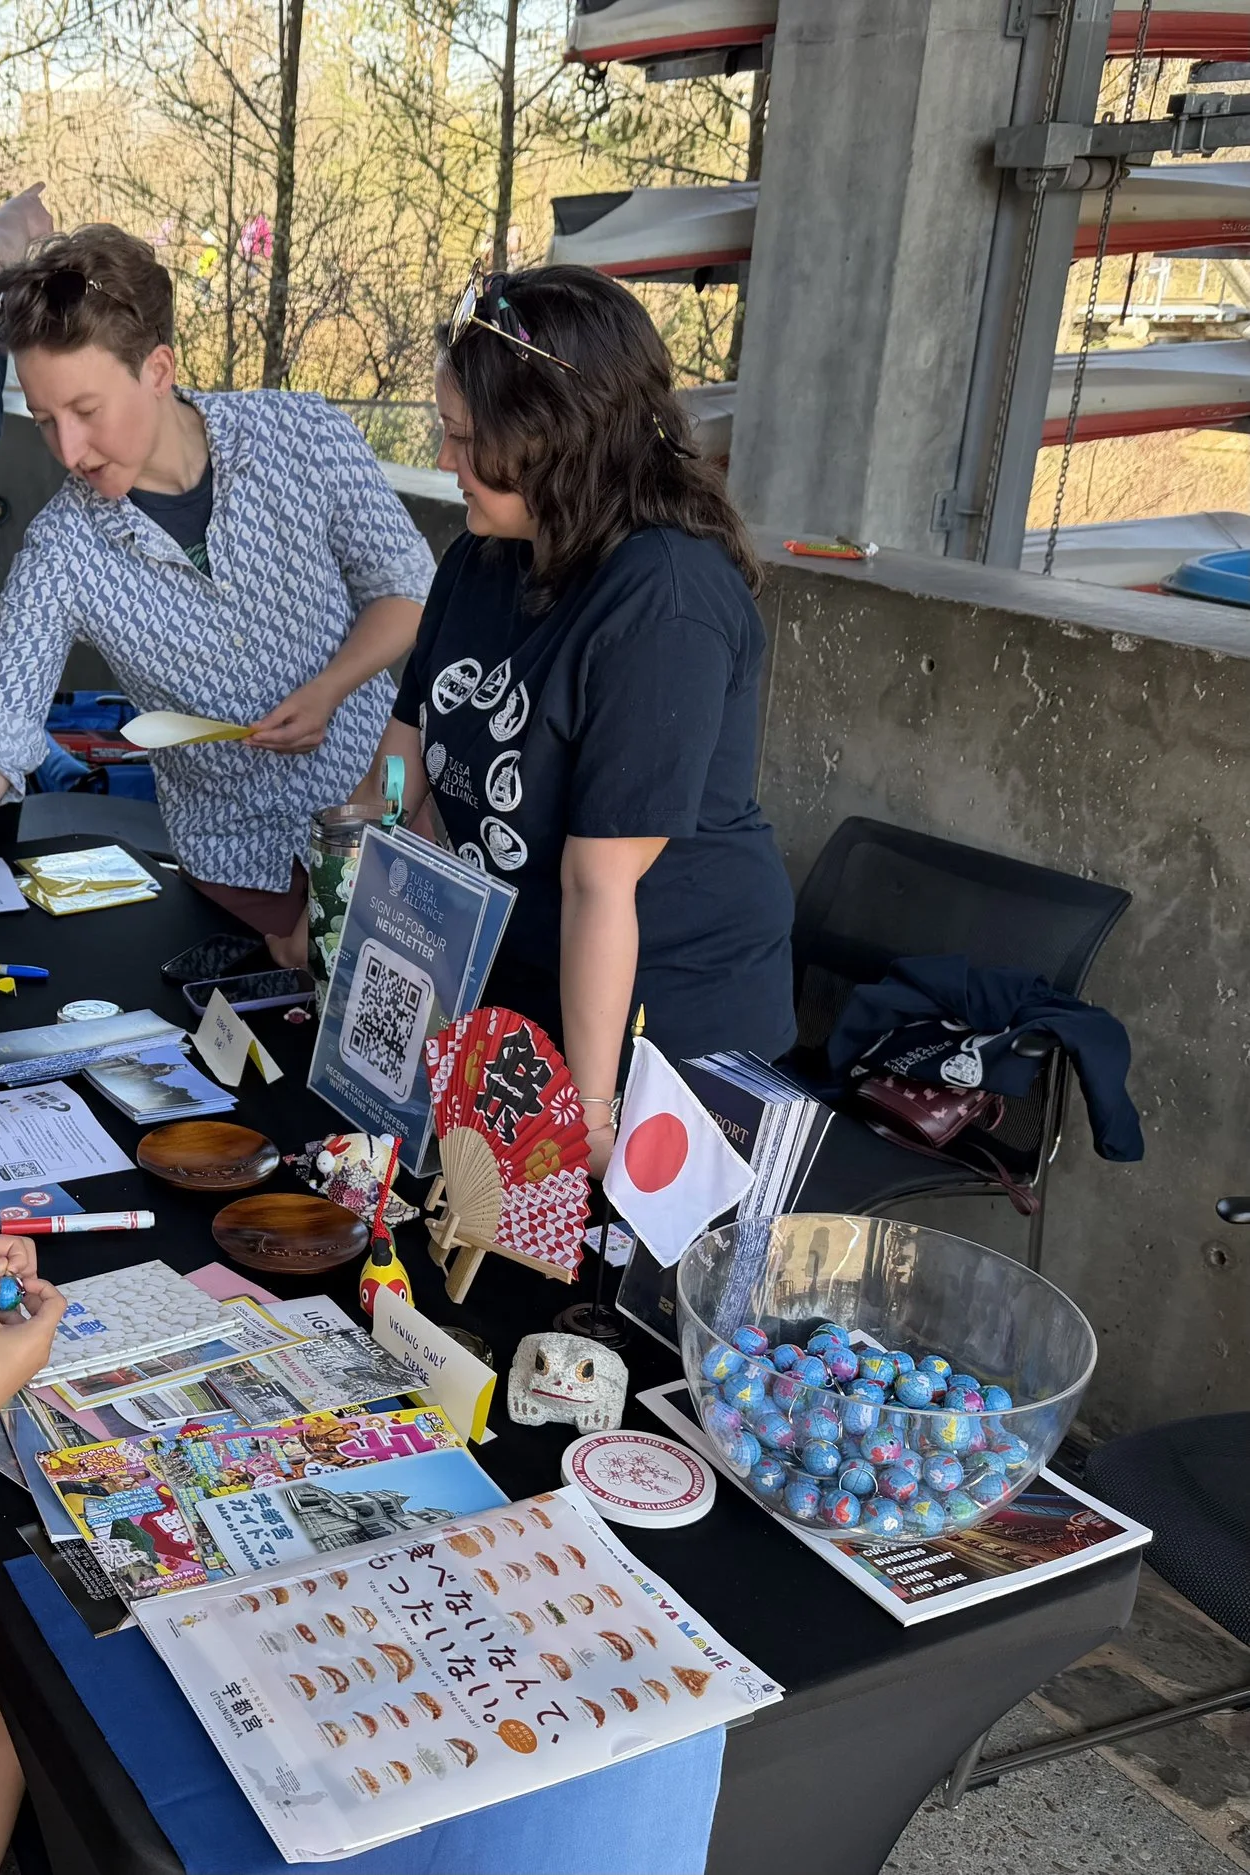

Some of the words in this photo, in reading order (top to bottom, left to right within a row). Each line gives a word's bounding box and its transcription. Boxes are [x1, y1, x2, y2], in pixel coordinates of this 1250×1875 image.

[440, 780, 479, 810] ALLIANCE
[444, 769, 473, 793] GLOBAL
[406, 882, 438, 909] GLOBAL
[410, 871, 435, 893] TULSA
[370, 896, 391, 917] SIGN
[391, 909, 404, 923] UP
[405, 917, 425, 938] FOR
[426, 931, 447, 952] OUR
[402, 893, 445, 924] ALLIANCE
[375, 916, 435, 962] NEWSLETTER
[325, 1063, 350, 1088] RECEIVE
[350, 1082, 384, 1115] EXCLUSIVE
[329, 1077, 366, 1113] INVITATIONS
[366, 1109, 381, 1124] AND
[708, 1110, 749, 1145] PORT
[389, 1315, 419, 1350] VIEWING
[423, 1346, 447, 1370] ONLY
[404, 1351, 430, 1382] PLEASE
[605, 1435, 636, 1444] SISTER
[637, 1437, 665, 1449] CITIES
[685, 1460, 705, 1498] ANNIVERSARY
[578, 1472, 599, 1493] JAPAN
[636, 1498, 689, 1511] OKLAHOMA
[215, 1503, 231, 1522] MAP
[251, 1492, 294, 1540] 宇都宮
[229, 1499, 281, 1567] ガイドマッ
[874, 1547, 927, 1567] BUSINESS
[886, 1551, 956, 1577] GOVERNMENT
[897, 1570, 933, 1586] LIVING
[910, 1583, 935, 1596] AND
[935, 1572, 968, 1590] MORE
[367, 1579, 379, 1595] You
[379, 1595, 401, 1624] haven't
[400, 1627, 417, 1647] tried
[415, 1648, 433, 1668] them
[368, 1552, 500, 1724] もったいない。
[209, 1690, 243, 1739] UTSUNOMIYA
[221, 1681, 263, 1733] 宇都宮
